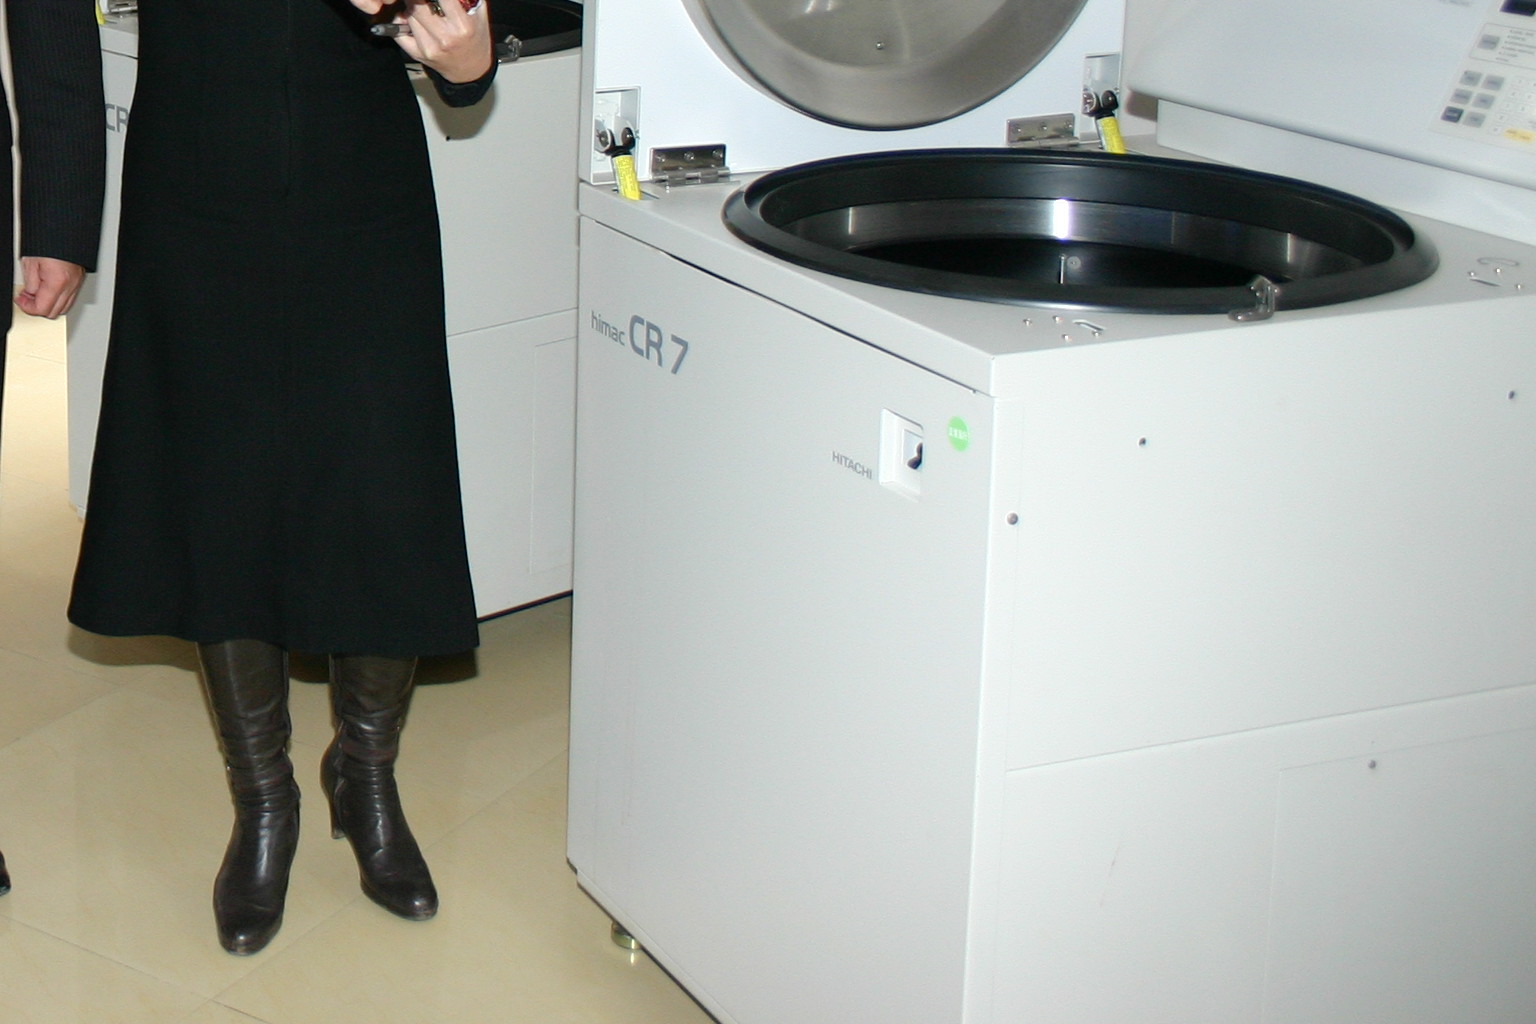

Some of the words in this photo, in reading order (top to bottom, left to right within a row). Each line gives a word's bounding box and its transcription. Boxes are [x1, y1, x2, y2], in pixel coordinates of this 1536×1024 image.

[591, 310, 626, 347] himac
[629, 314, 663, 368] CR
[670, 333, 689, 375] 7
[832, 450, 873, 480] HITACHI
